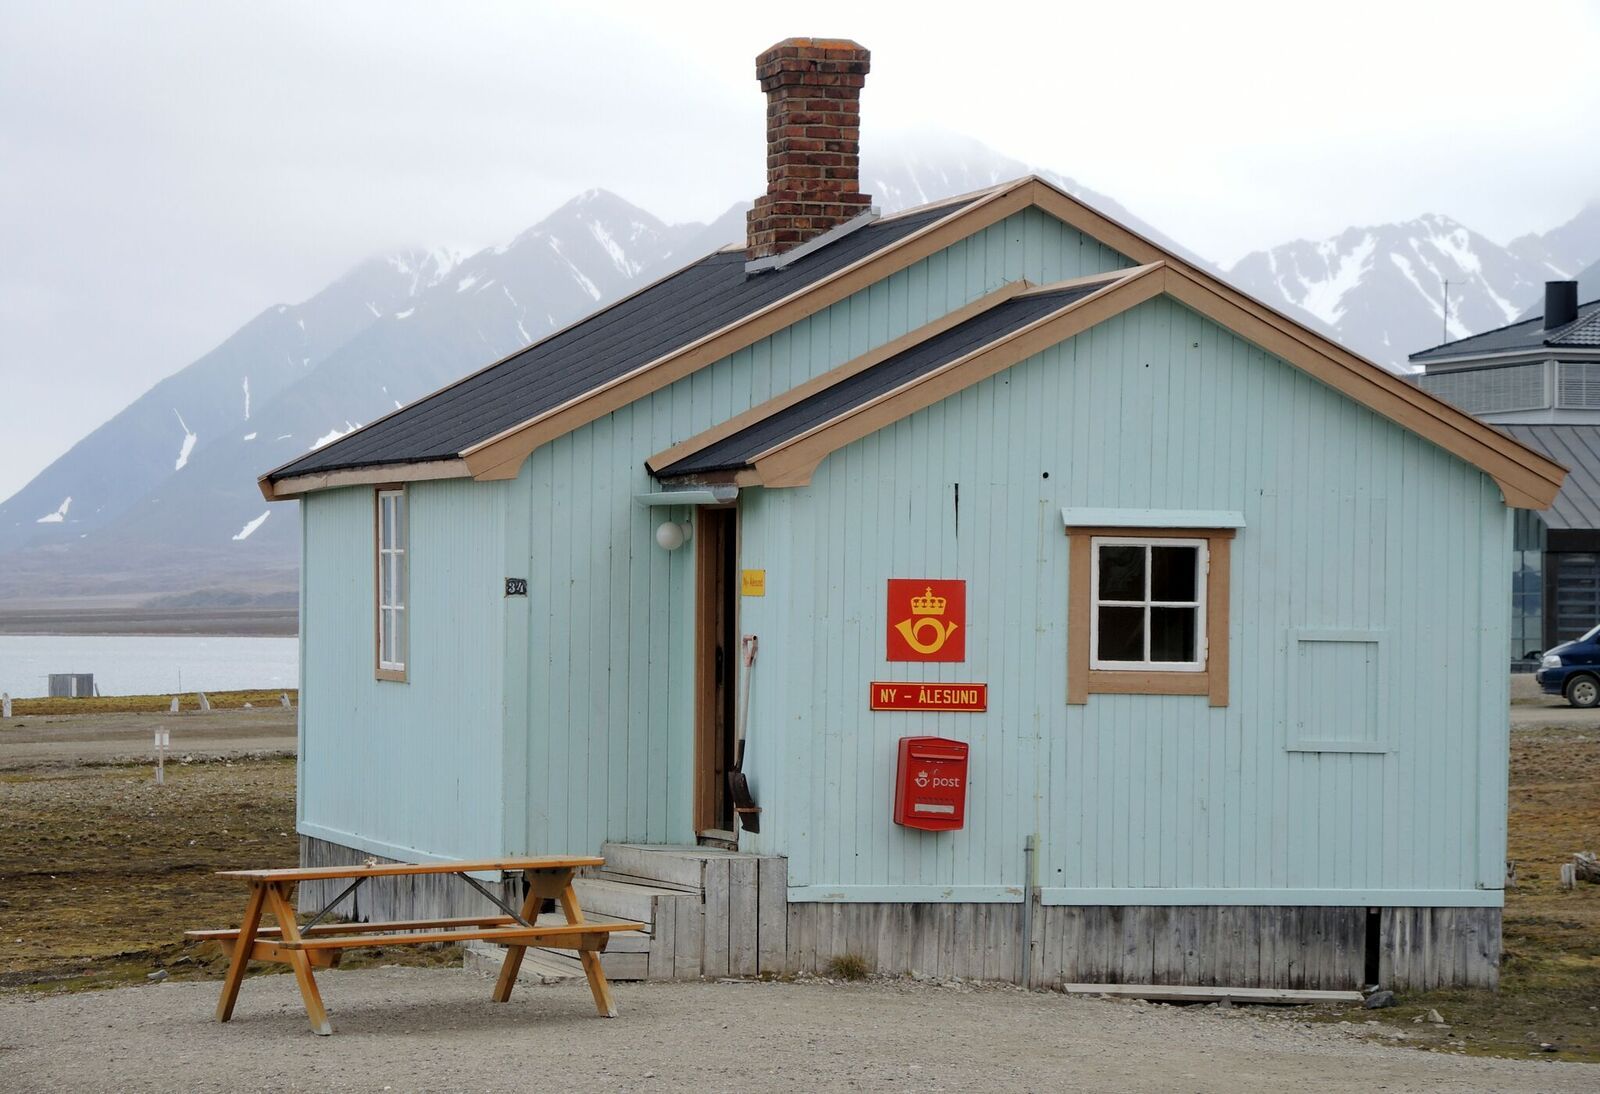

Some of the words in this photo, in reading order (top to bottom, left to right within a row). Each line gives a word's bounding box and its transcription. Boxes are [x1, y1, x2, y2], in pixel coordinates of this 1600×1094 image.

[508, 582, 524, 594] 34
[880, 688, 897, 703] NY
[918, 685, 978, 704] ÅLESUND
[932, 777, 961, 789] post
